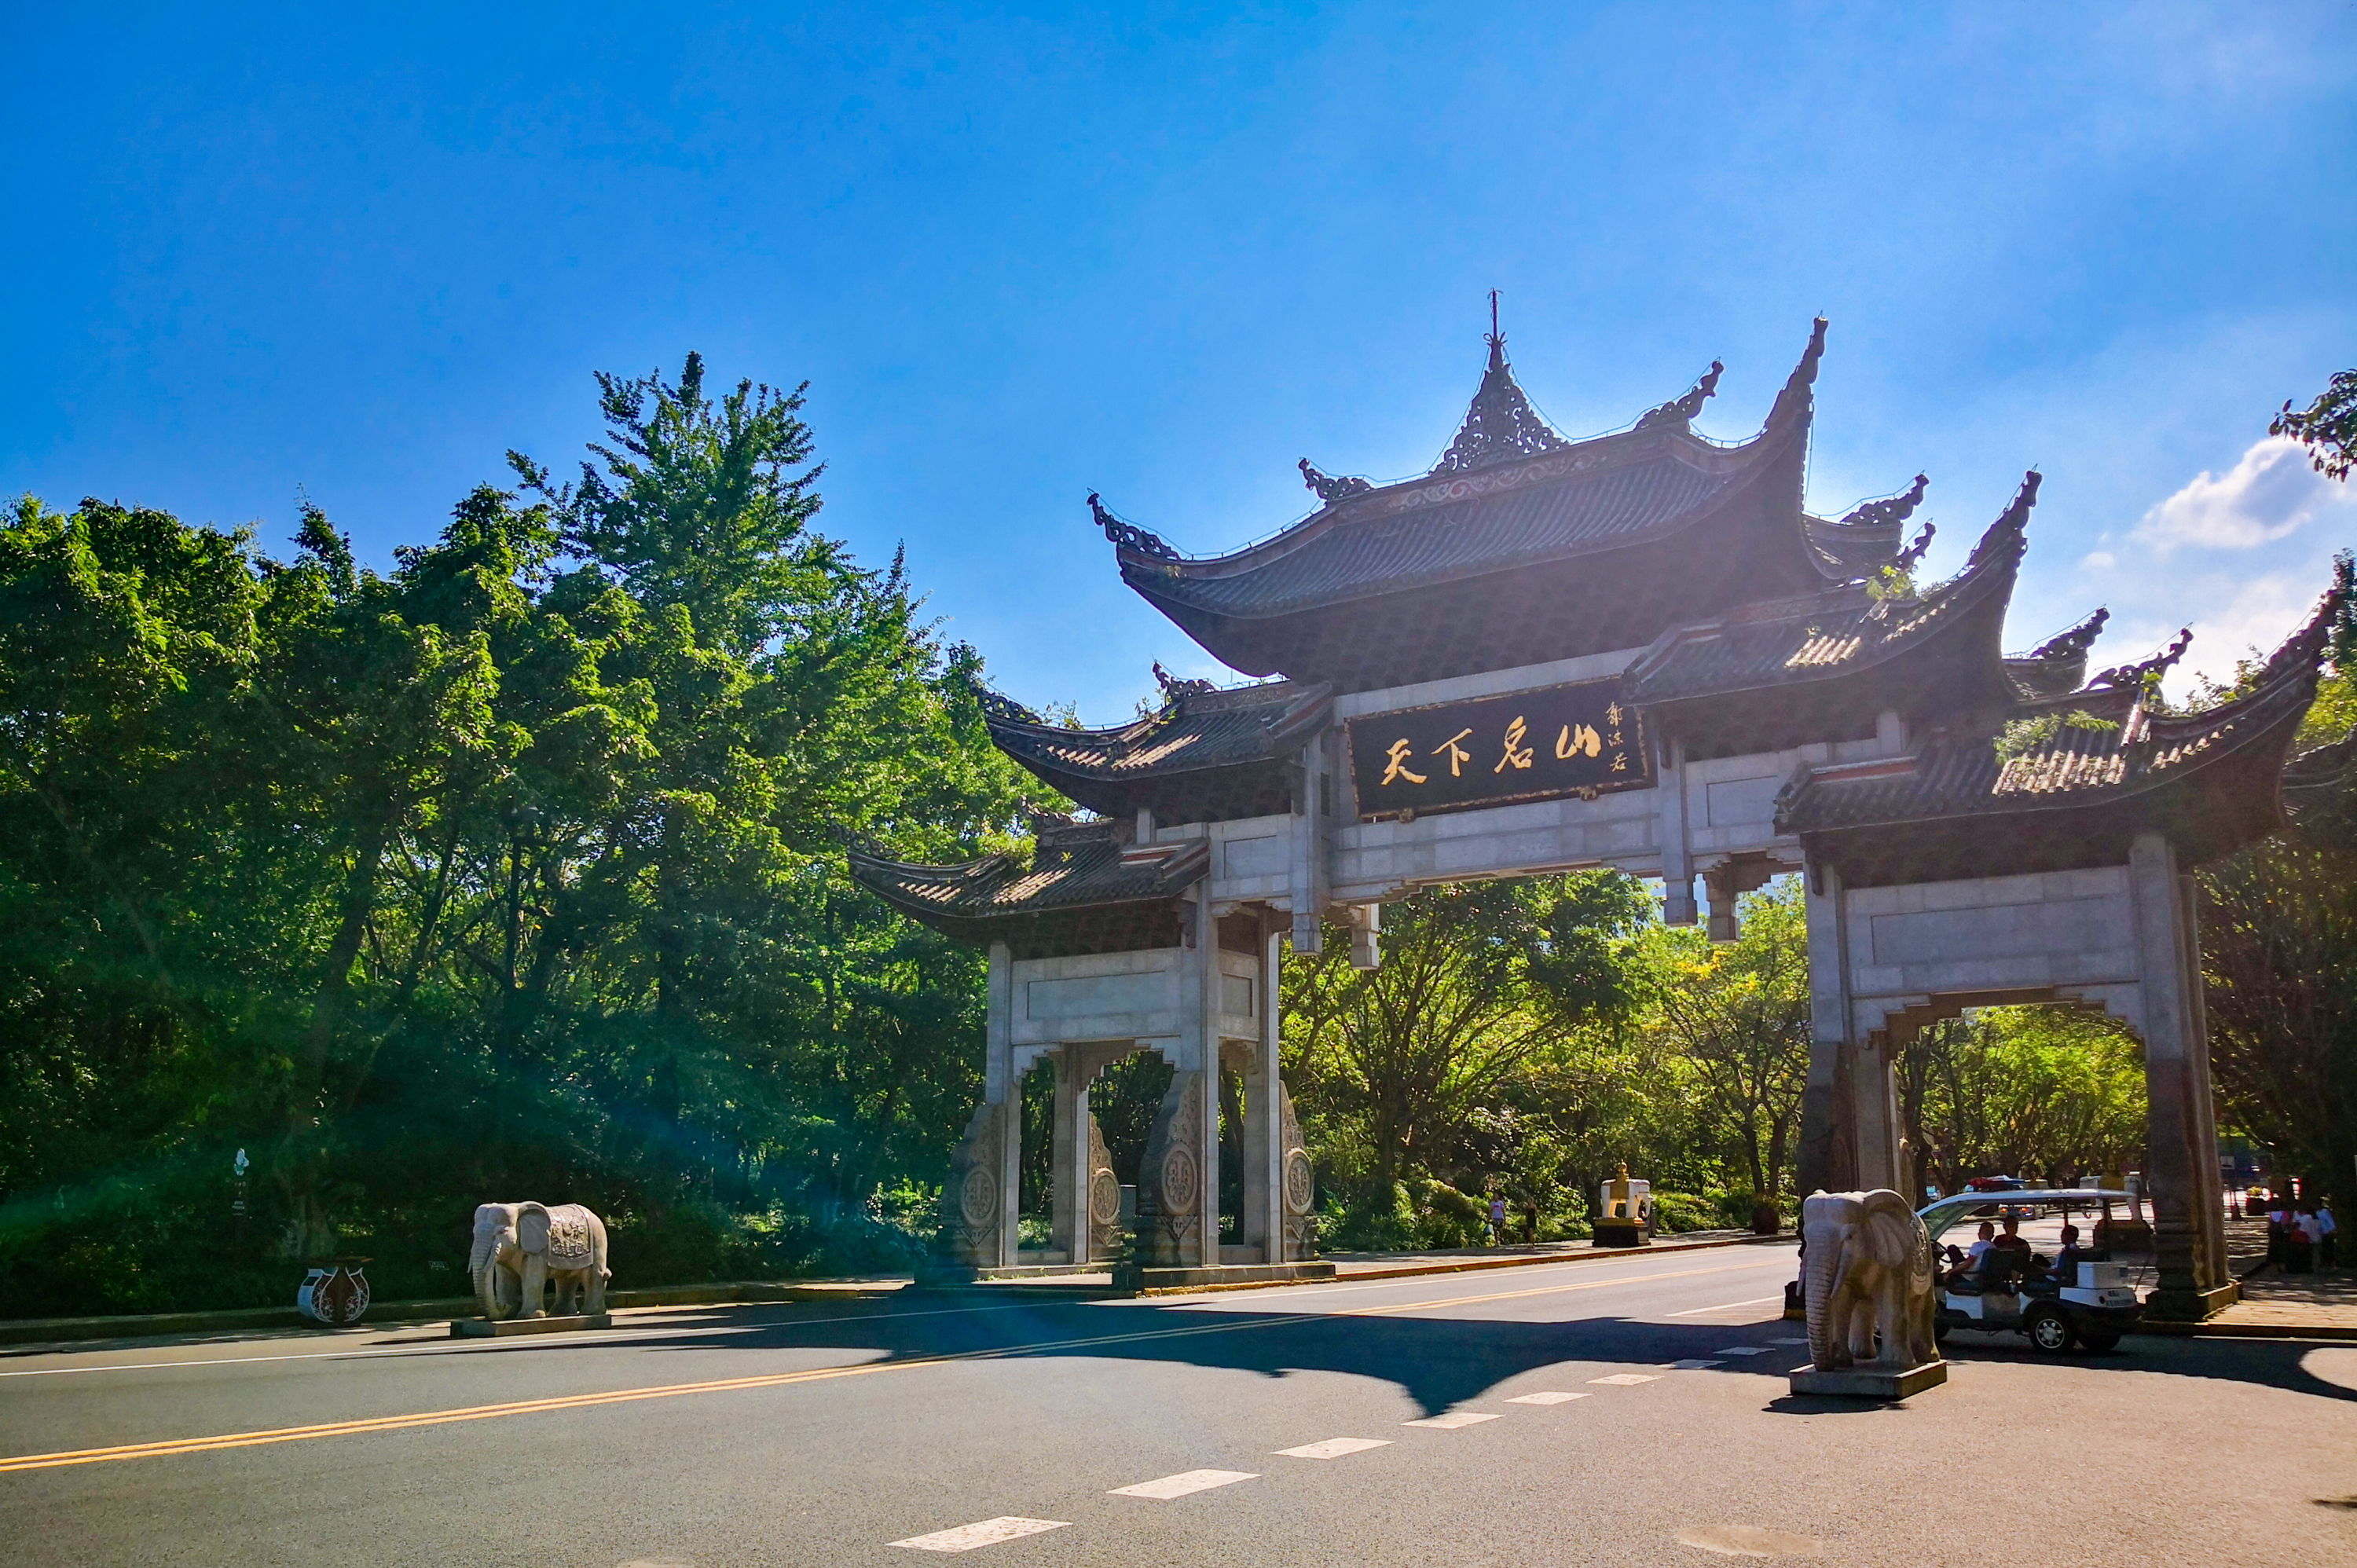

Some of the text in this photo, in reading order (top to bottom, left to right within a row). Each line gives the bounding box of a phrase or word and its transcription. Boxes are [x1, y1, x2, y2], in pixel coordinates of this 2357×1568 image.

[1380, 716, 1602, 786] 天下名山
[1605, 701, 1628, 772] 郭沫若
